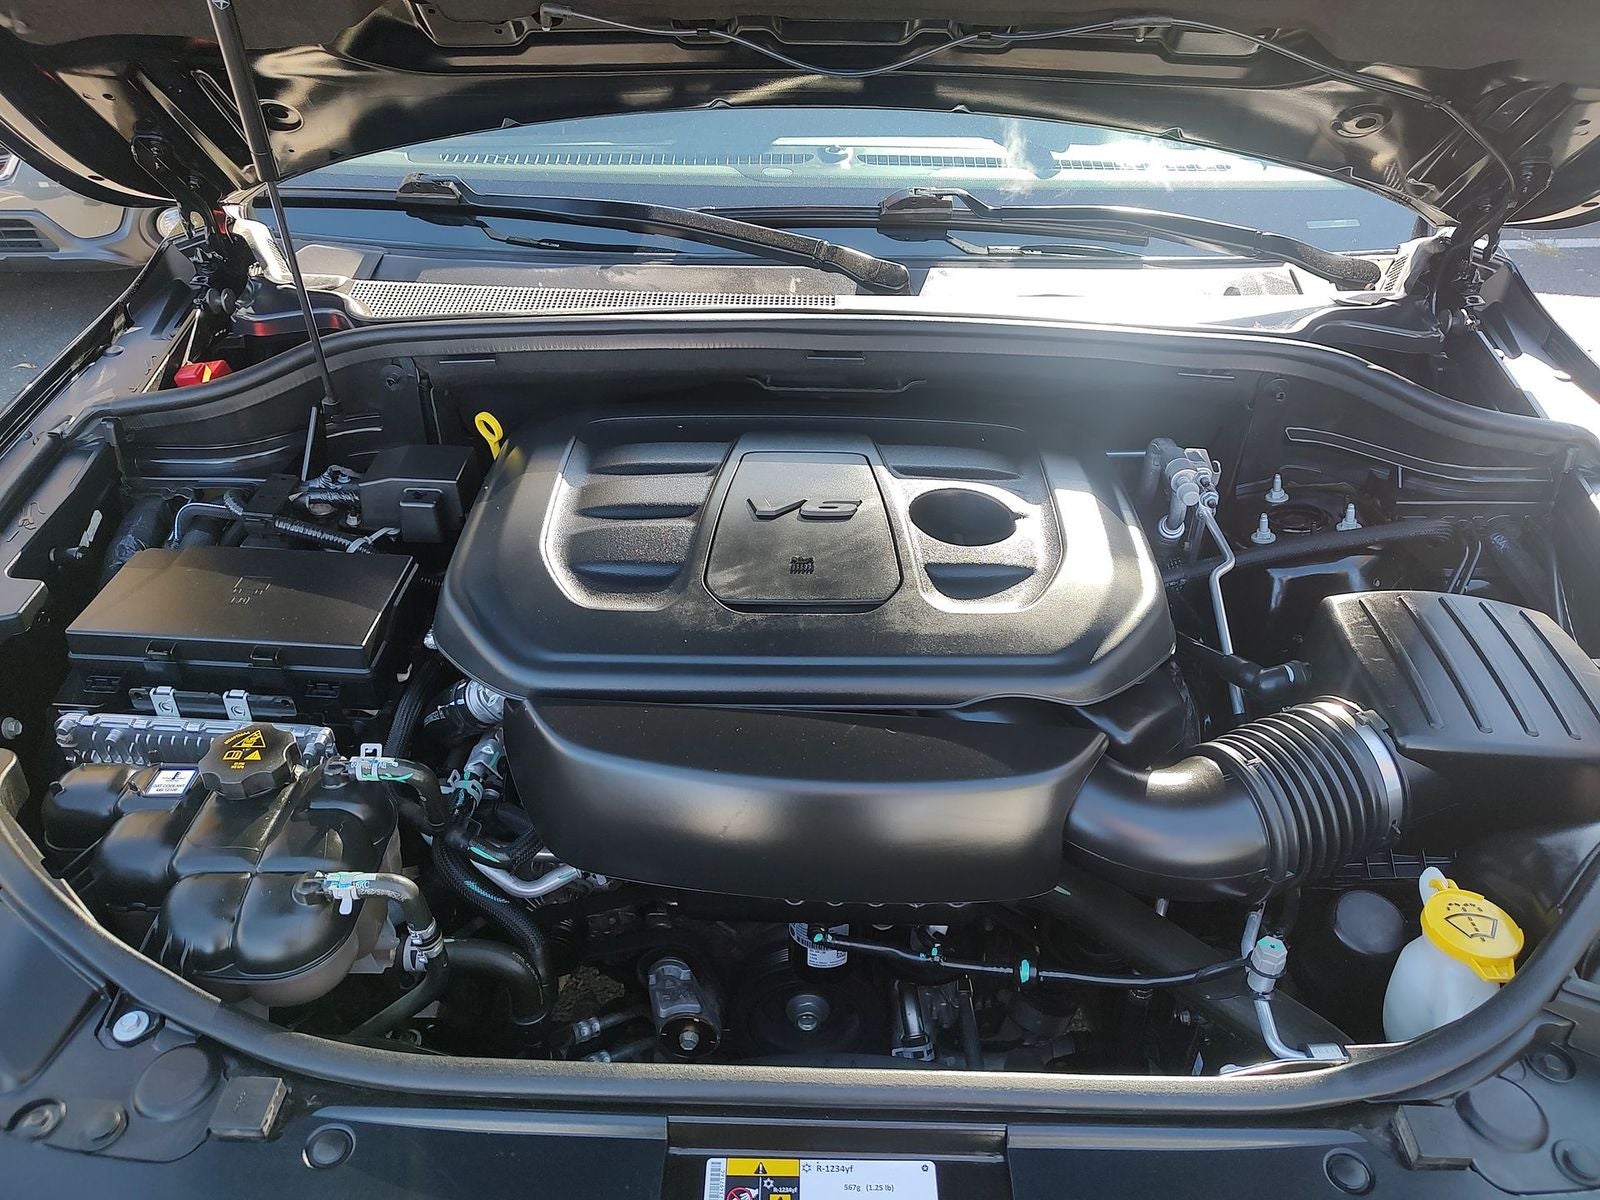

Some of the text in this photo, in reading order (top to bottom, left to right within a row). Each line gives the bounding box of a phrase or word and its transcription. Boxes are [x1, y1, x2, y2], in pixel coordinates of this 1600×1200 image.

[746, 498, 862, 521] V6
[816, 1164, 854, 1173] R-1234yf
[844, 1184, 895, 1192] 567g (1.25 lb)
